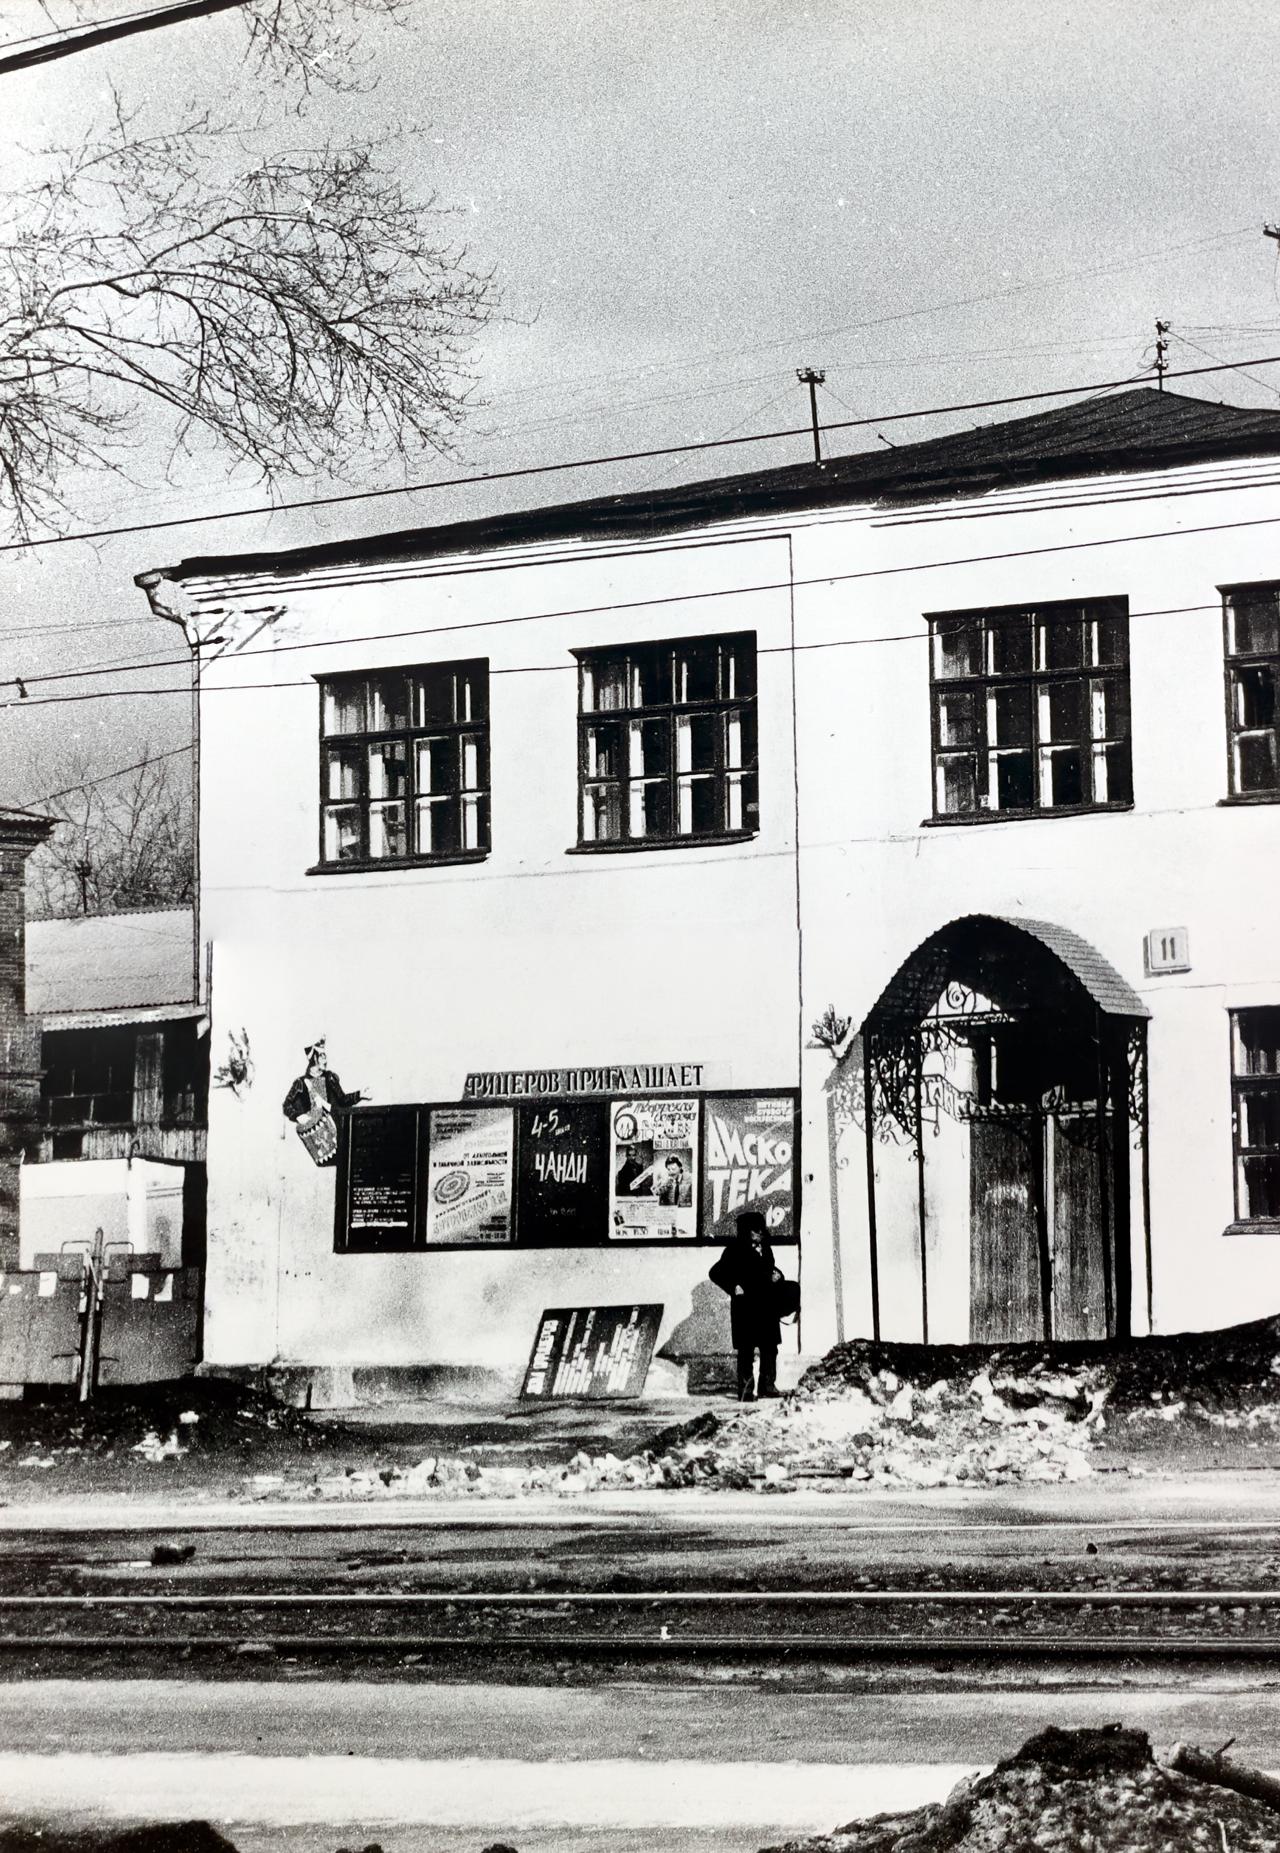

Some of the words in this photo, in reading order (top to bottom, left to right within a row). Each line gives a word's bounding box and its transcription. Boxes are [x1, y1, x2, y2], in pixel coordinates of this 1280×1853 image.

[1161, 937, 1176, 961] 11
[565, 1065, 704, 1095] ПРИГЛАШАЕТ
[531, 1108, 559, 1138] 4-5
[708, 1112, 792, 1166] ДИСКО
[535, 1151, 588, 1184] ЧАНДИ
[708, 1168, 792, 1223] ТЕКА
